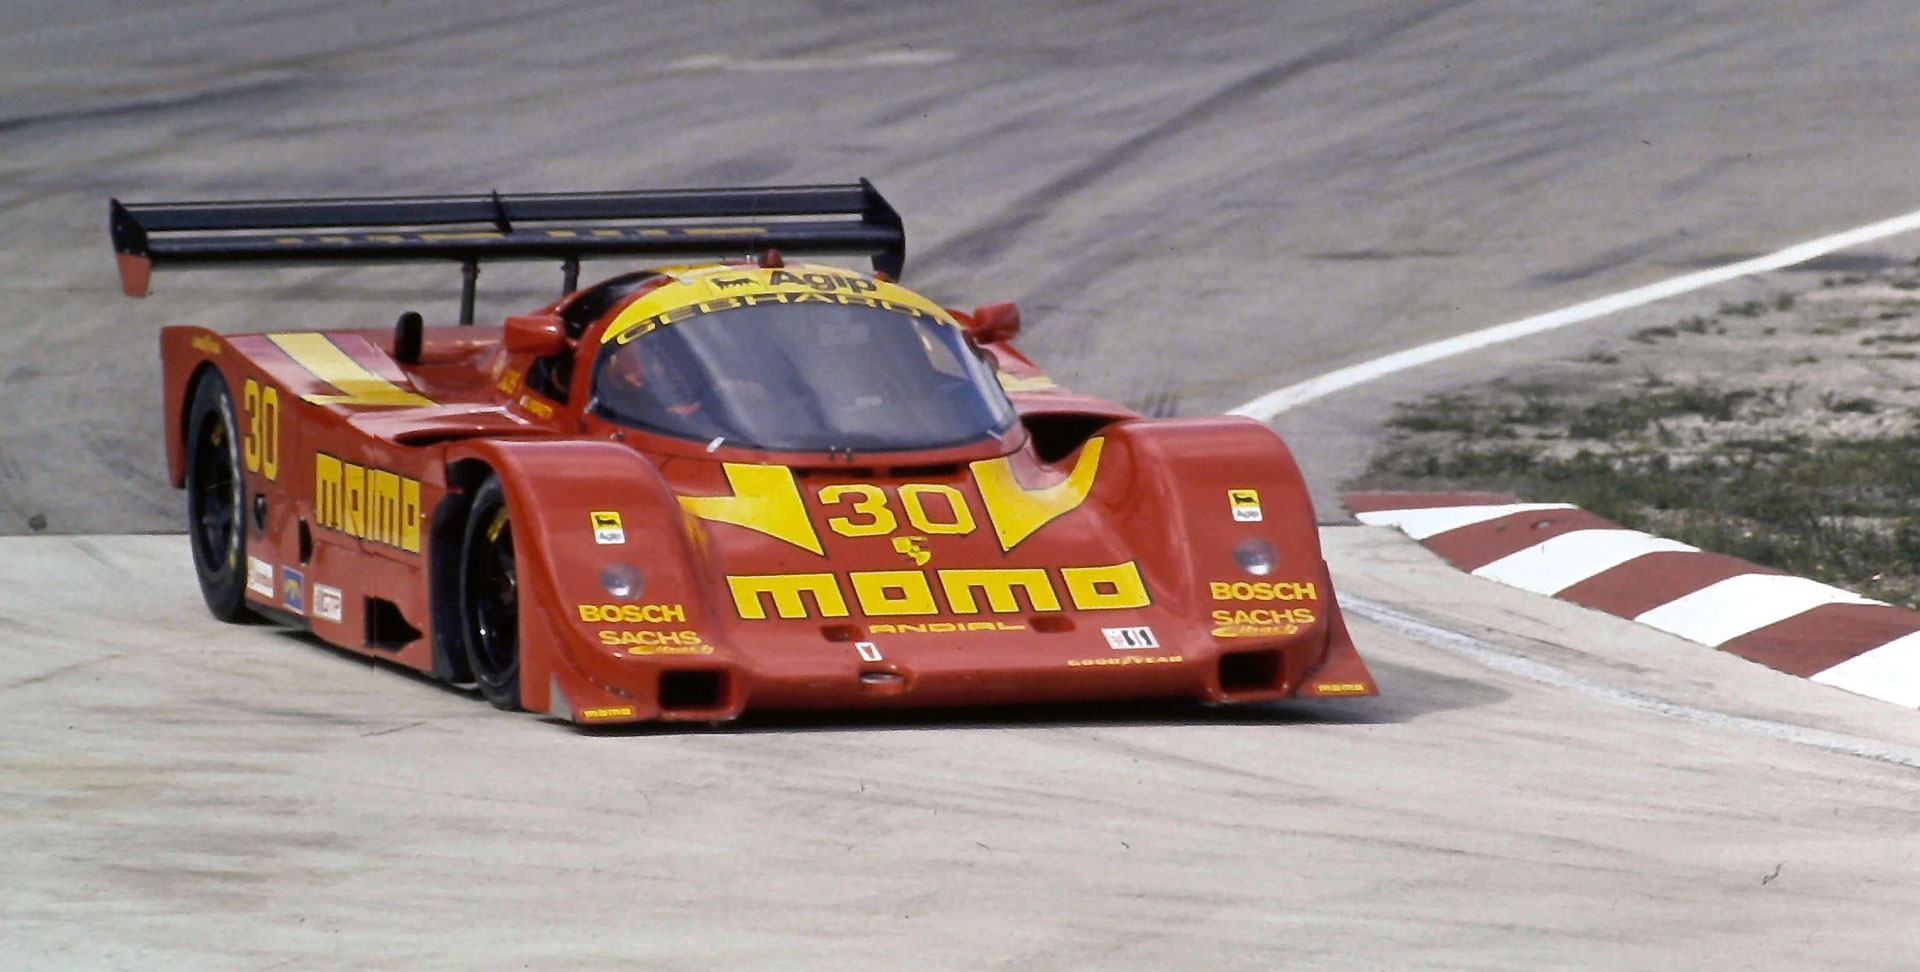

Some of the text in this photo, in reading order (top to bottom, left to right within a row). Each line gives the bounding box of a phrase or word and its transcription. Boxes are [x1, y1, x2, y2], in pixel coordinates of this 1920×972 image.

[770, 270, 877, 293] Agip
[245, 377, 278, 481] 30
[316, 453, 421, 554] momo
[819, 483, 976, 536] 30
[726, 561, 1151, 619] momo
[1210, 582, 1317, 600] BOSCH
[578, 604, 686, 623] BOSCH
[1211, 608, 1315, 625] SACHS
[869, 621, 1026, 634] ANDIAL
[598, 630, 701, 645] SACHS
[583, 706, 632, 717] momo
